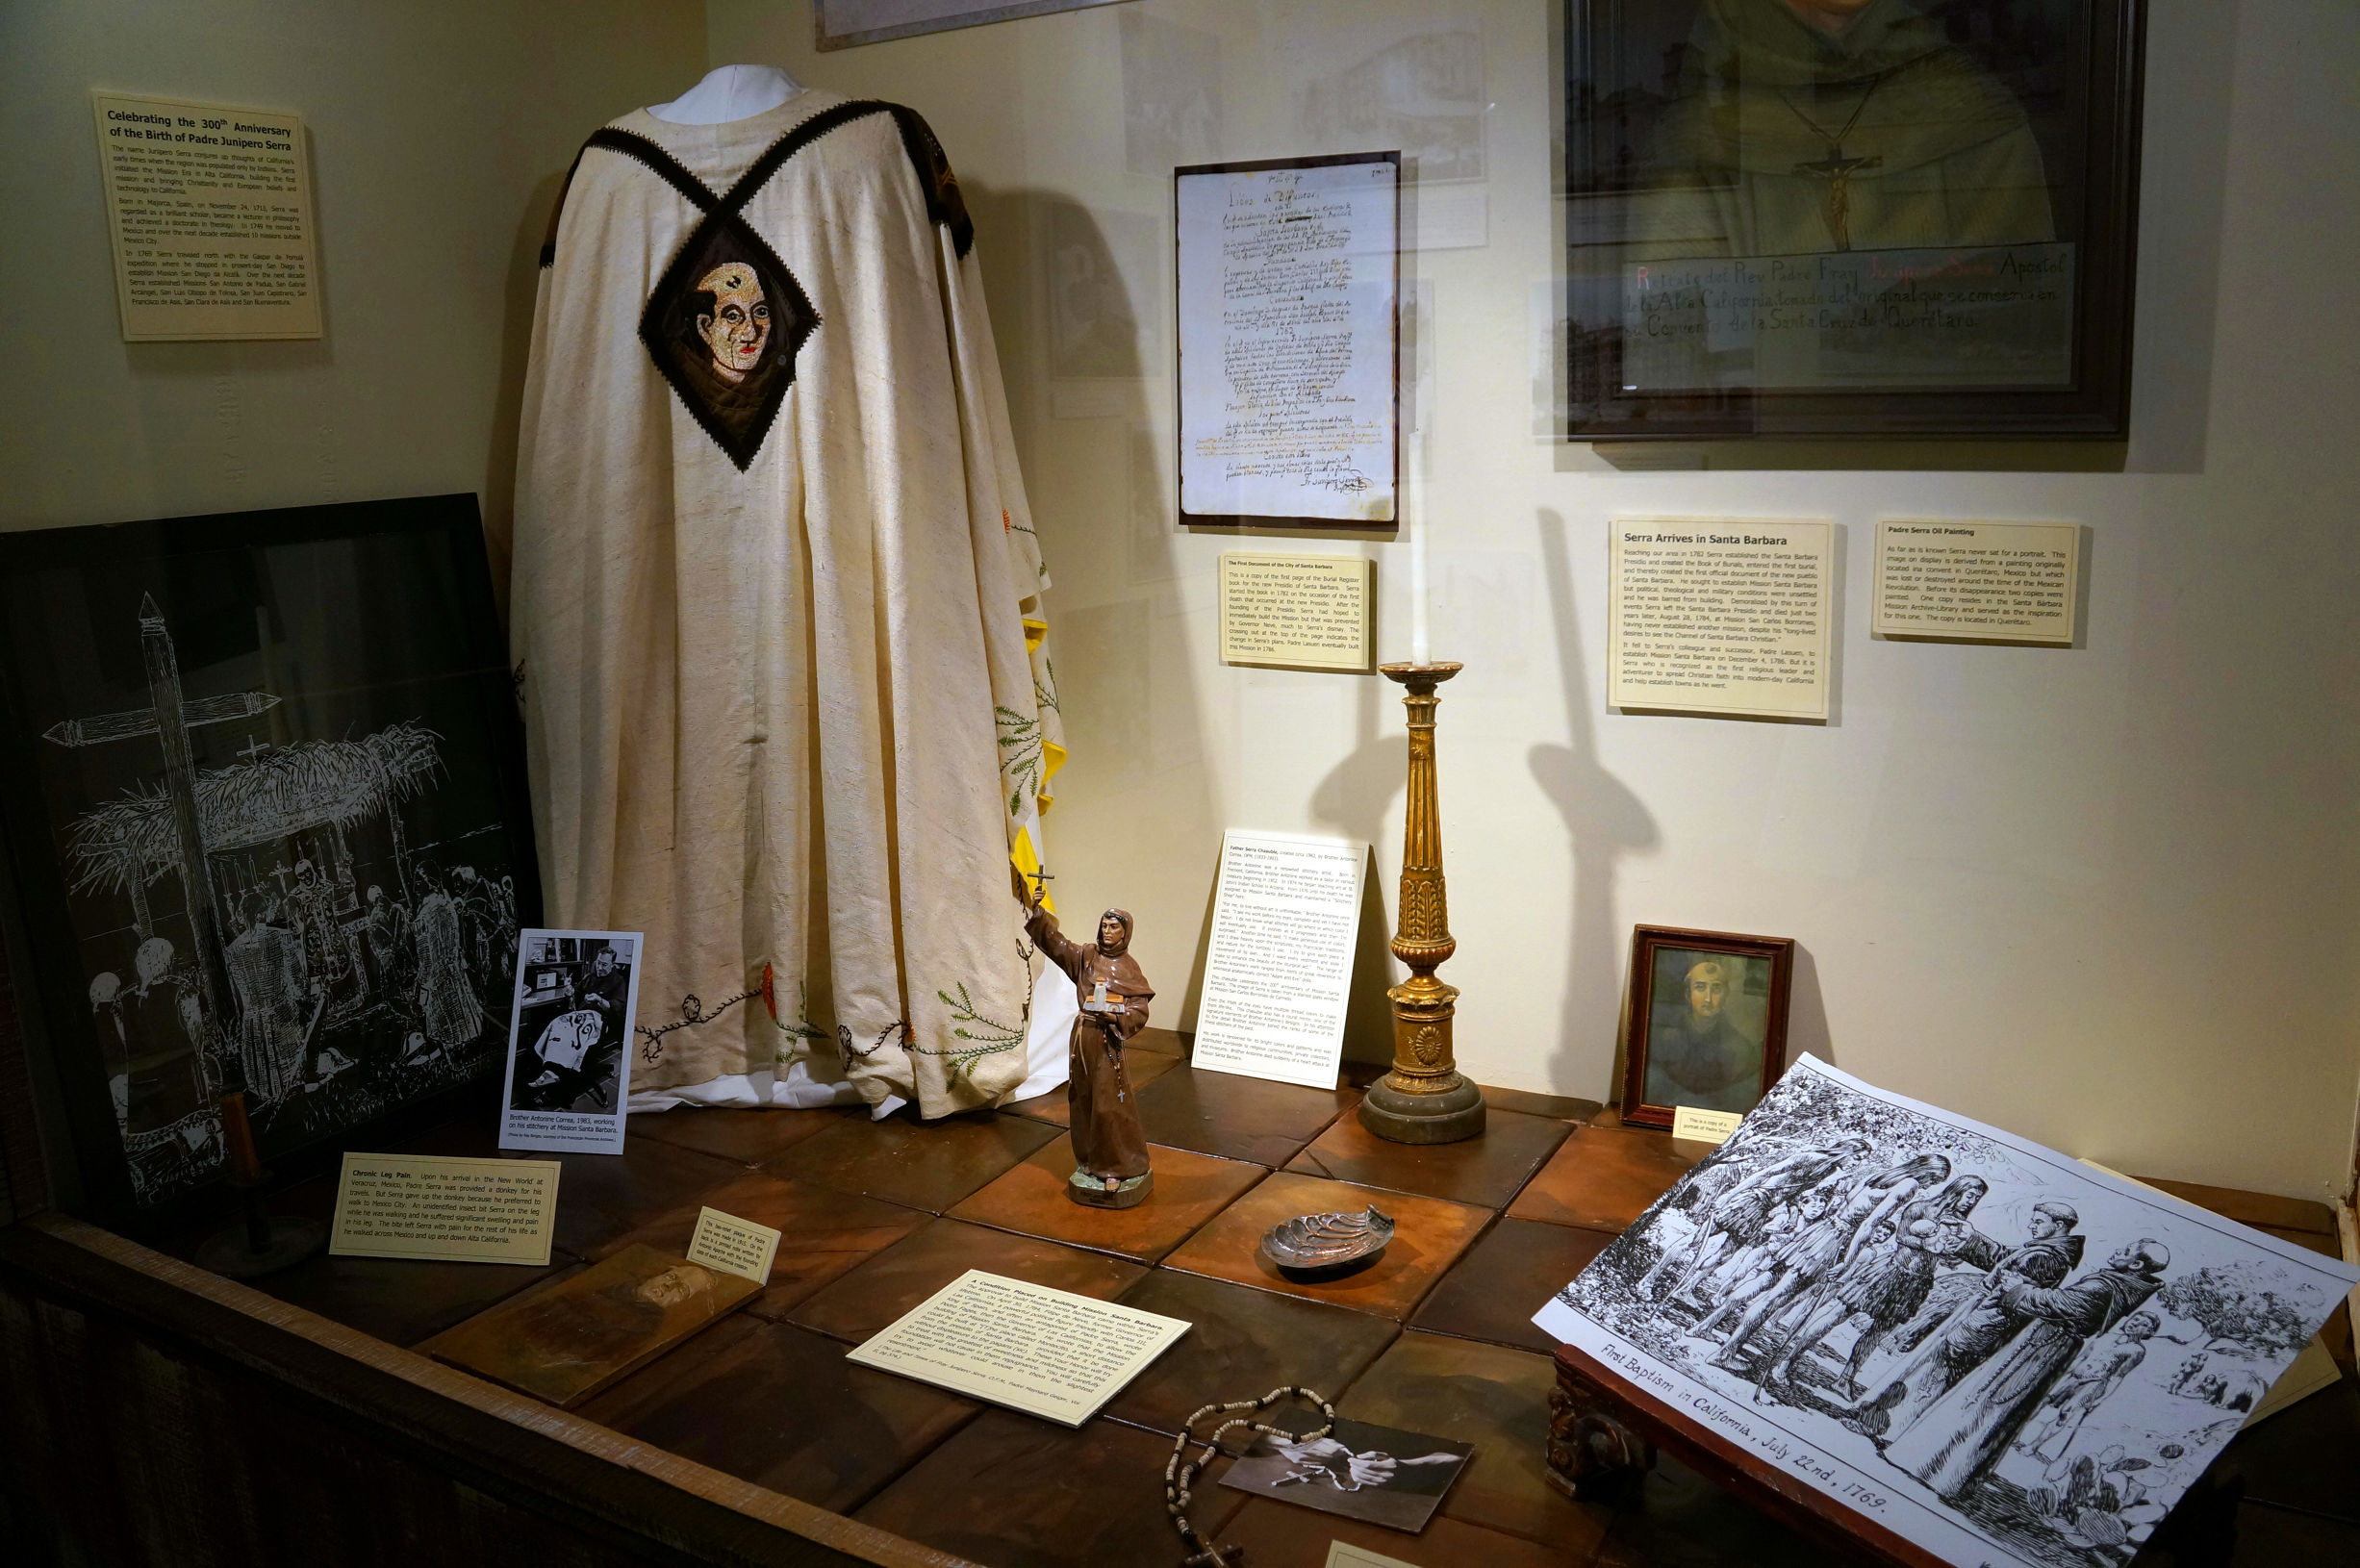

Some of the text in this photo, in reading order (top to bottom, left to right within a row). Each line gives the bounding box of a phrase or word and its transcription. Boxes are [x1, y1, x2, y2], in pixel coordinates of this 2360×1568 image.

[107, 110, 171, 127] Celebrating
[177, 116, 195, 127] the
[234, 122, 291, 138] Anniversary
[110, 127, 291, 151] of the Birth of Padre Junipero Serra
[1624, 532, 1787, 544] Serra Arrives in Santa Barbara
[1943, 528, 1974, 537] Painting
[444, 1193, 465, 1202] donkey
[495, 1186, 518, 1195] donkey
[979, 1280, 1010, 1291] Condition
[1013, 1289, 1036, 1298] Placed
[1050, 1299, 1078, 1308] Building
[1080, 1306, 1107, 1315] Mission
[1109, 1313, 1130, 1322] Santa
[1601, 1344, 1627, 1363] First
[1624, 1357, 1674, 1392] Baptism
[1678, 1389, 1691, 1402] in
[1761, 1436, 1791, 1460] July
[1841, 1481, 1886, 1513] 1769.
